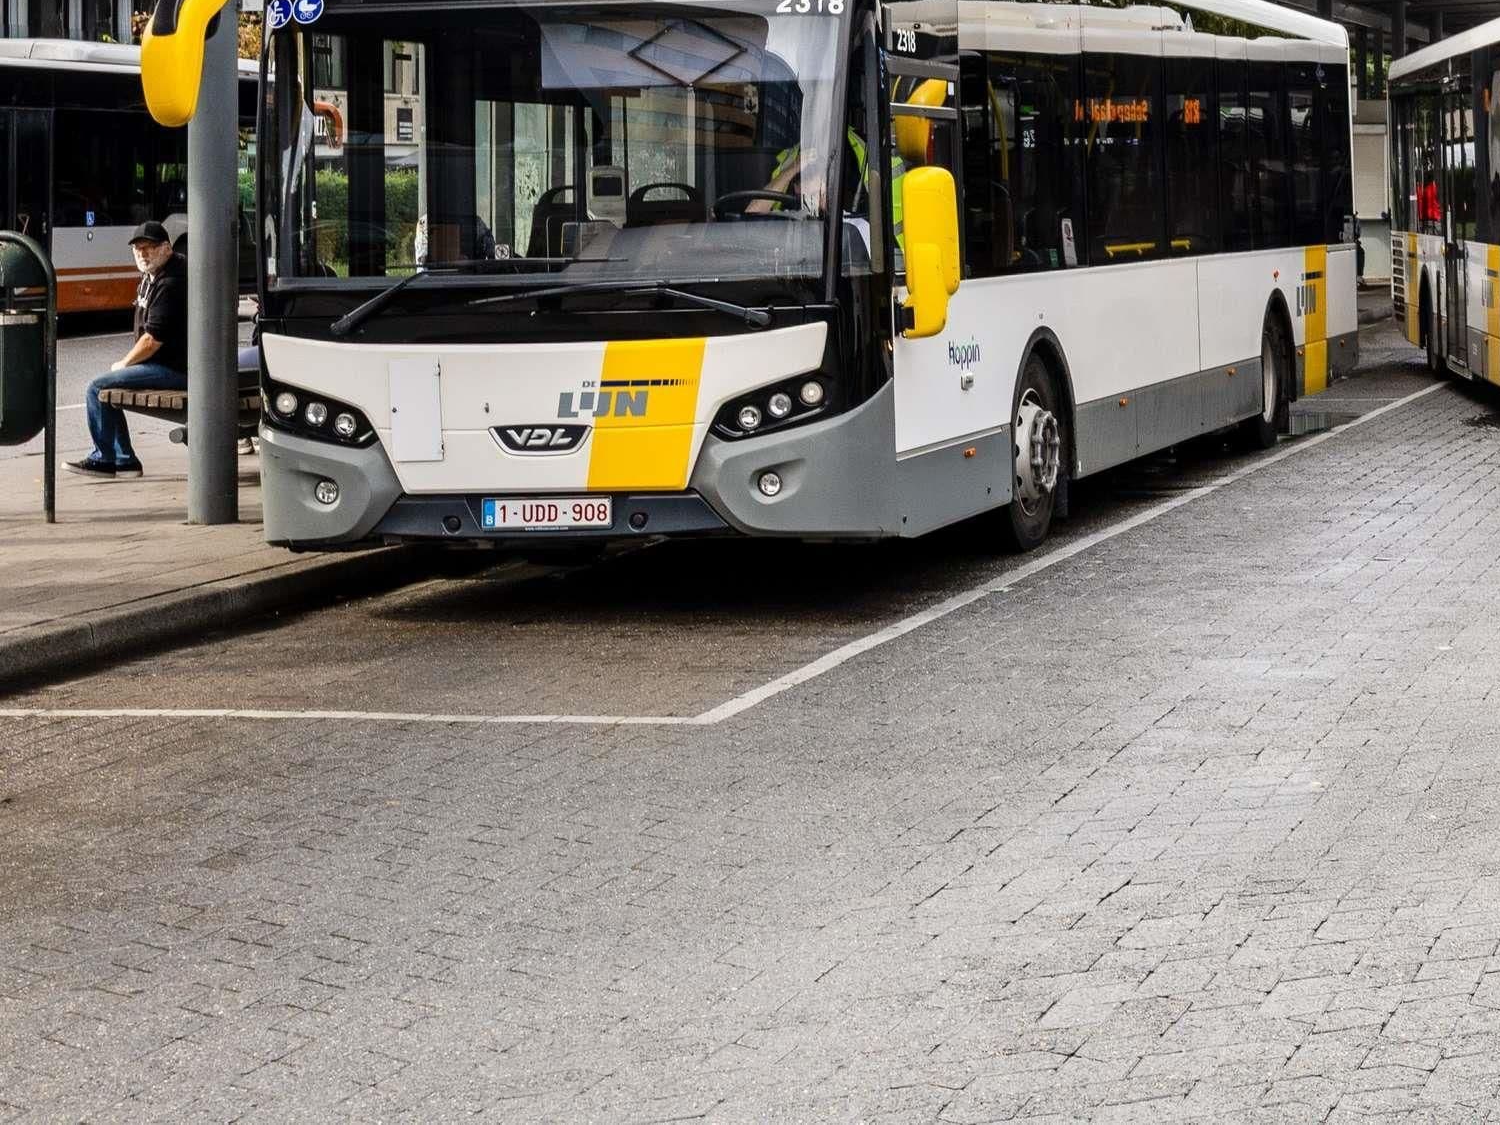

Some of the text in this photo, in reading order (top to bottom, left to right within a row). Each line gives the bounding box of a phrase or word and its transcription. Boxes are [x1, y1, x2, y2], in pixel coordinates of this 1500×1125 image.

[896, 29, 917, 53] 2318
[948, 335, 981, 370] Hoppin
[582, 380, 597, 388] DE
[557, 390, 650, 418] LIJN
[506, 428, 573, 447] VDL
